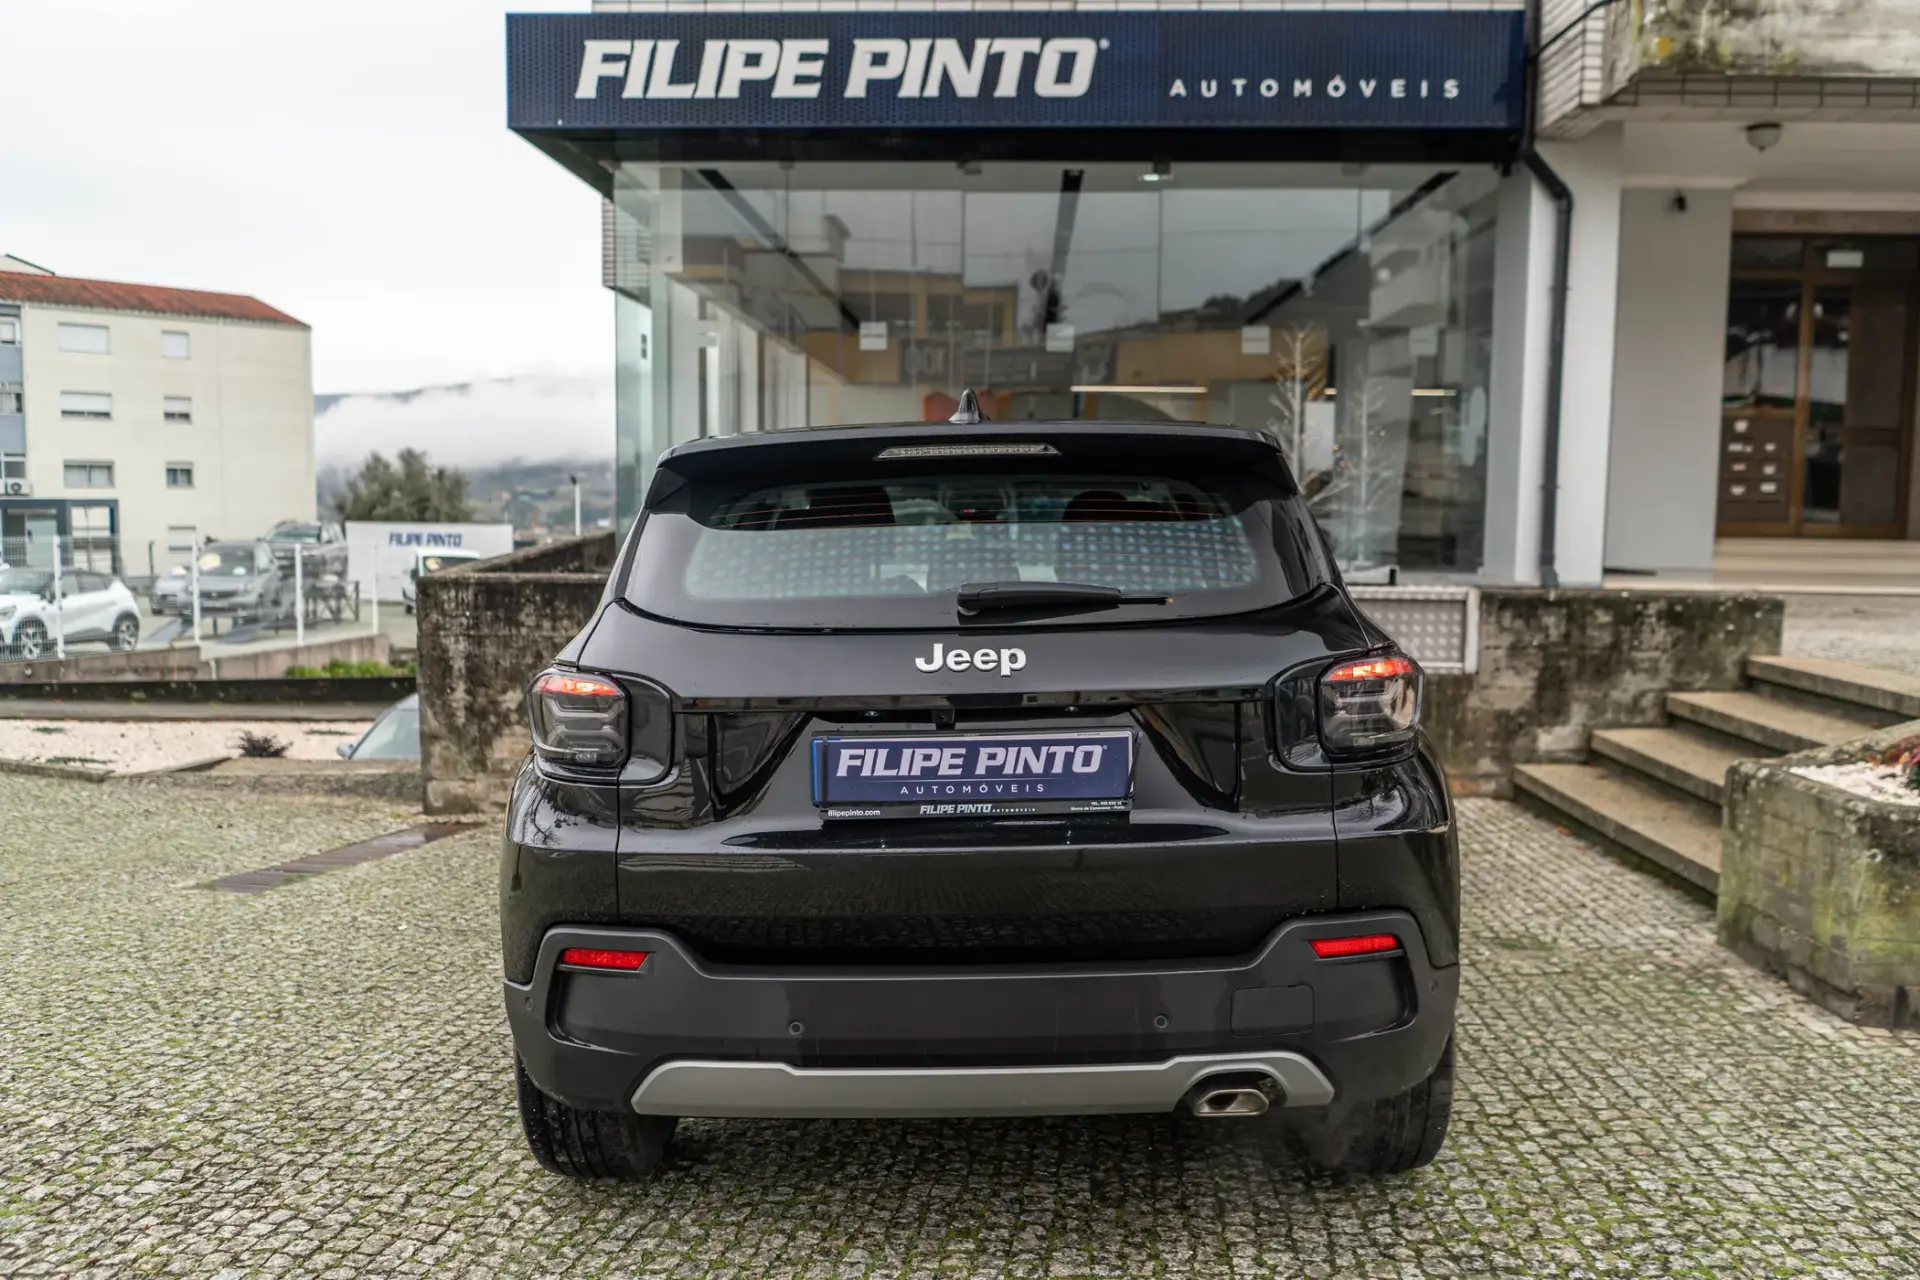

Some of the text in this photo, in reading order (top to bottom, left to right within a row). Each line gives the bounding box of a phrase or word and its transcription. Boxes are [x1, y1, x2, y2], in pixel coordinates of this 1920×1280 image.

[575, 38, 1460, 100] FILIPE PINTO AUTOMÓVEIS
[914, 643, 1027, 677] Jeep
[836, 744, 1103, 777] FILIPE PINTO
[900, 783, 1044, 795] AUTOMÓVEIS
[828, 809, 881, 817] filipepinto.com
[919, 804, 956, 814] FILIPE
[956, 803, 993, 813] PINTO
